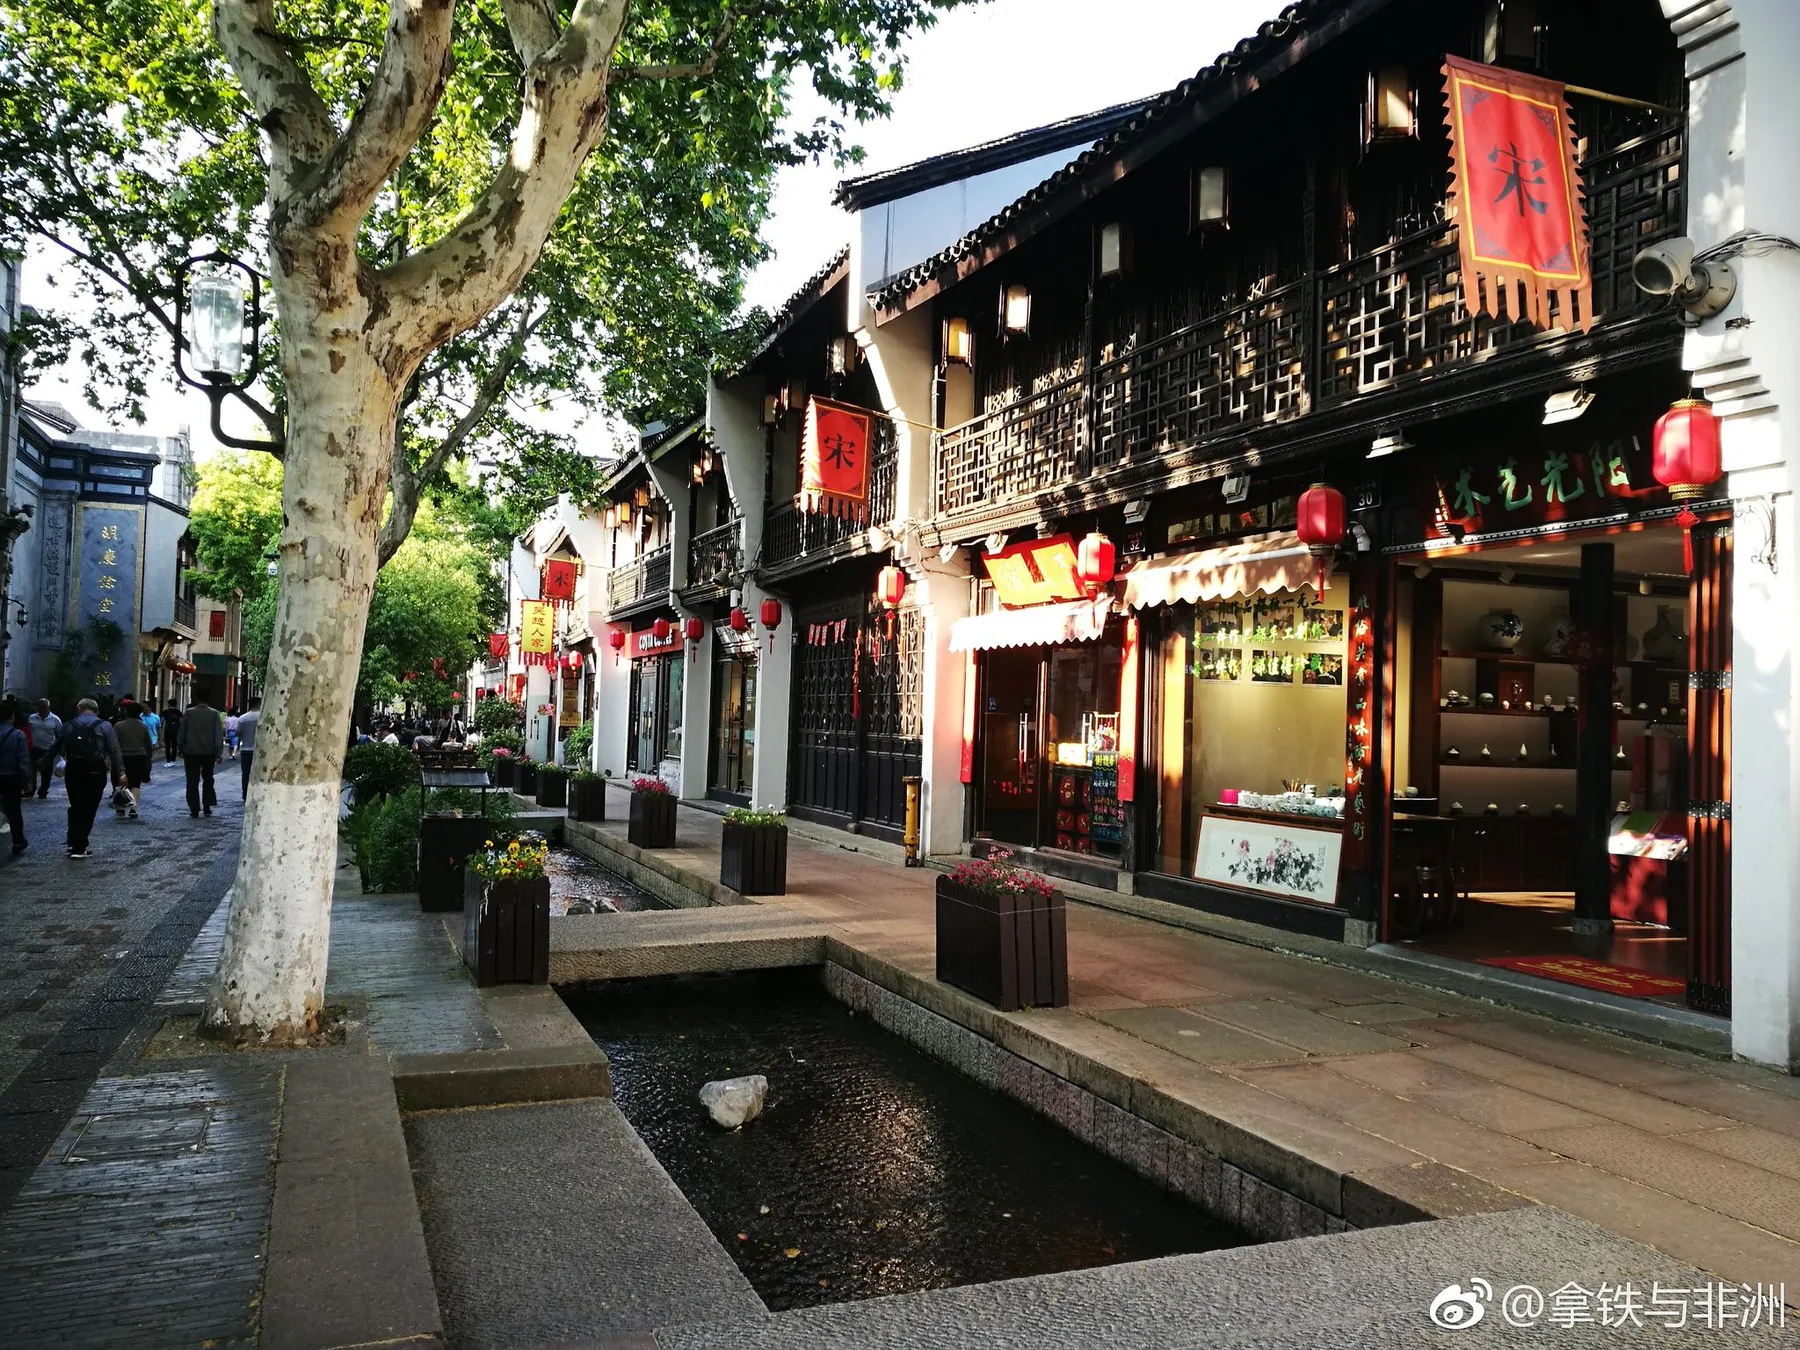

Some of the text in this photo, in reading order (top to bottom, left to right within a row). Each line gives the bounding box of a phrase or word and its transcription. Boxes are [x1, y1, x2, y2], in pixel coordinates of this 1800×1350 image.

[1487, 141, 1549, 218] 宋
[823, 433, 857, 470] 宋
[1358, 491, 1374, 507] 30
[1129, 539, 1141, 552] 32
